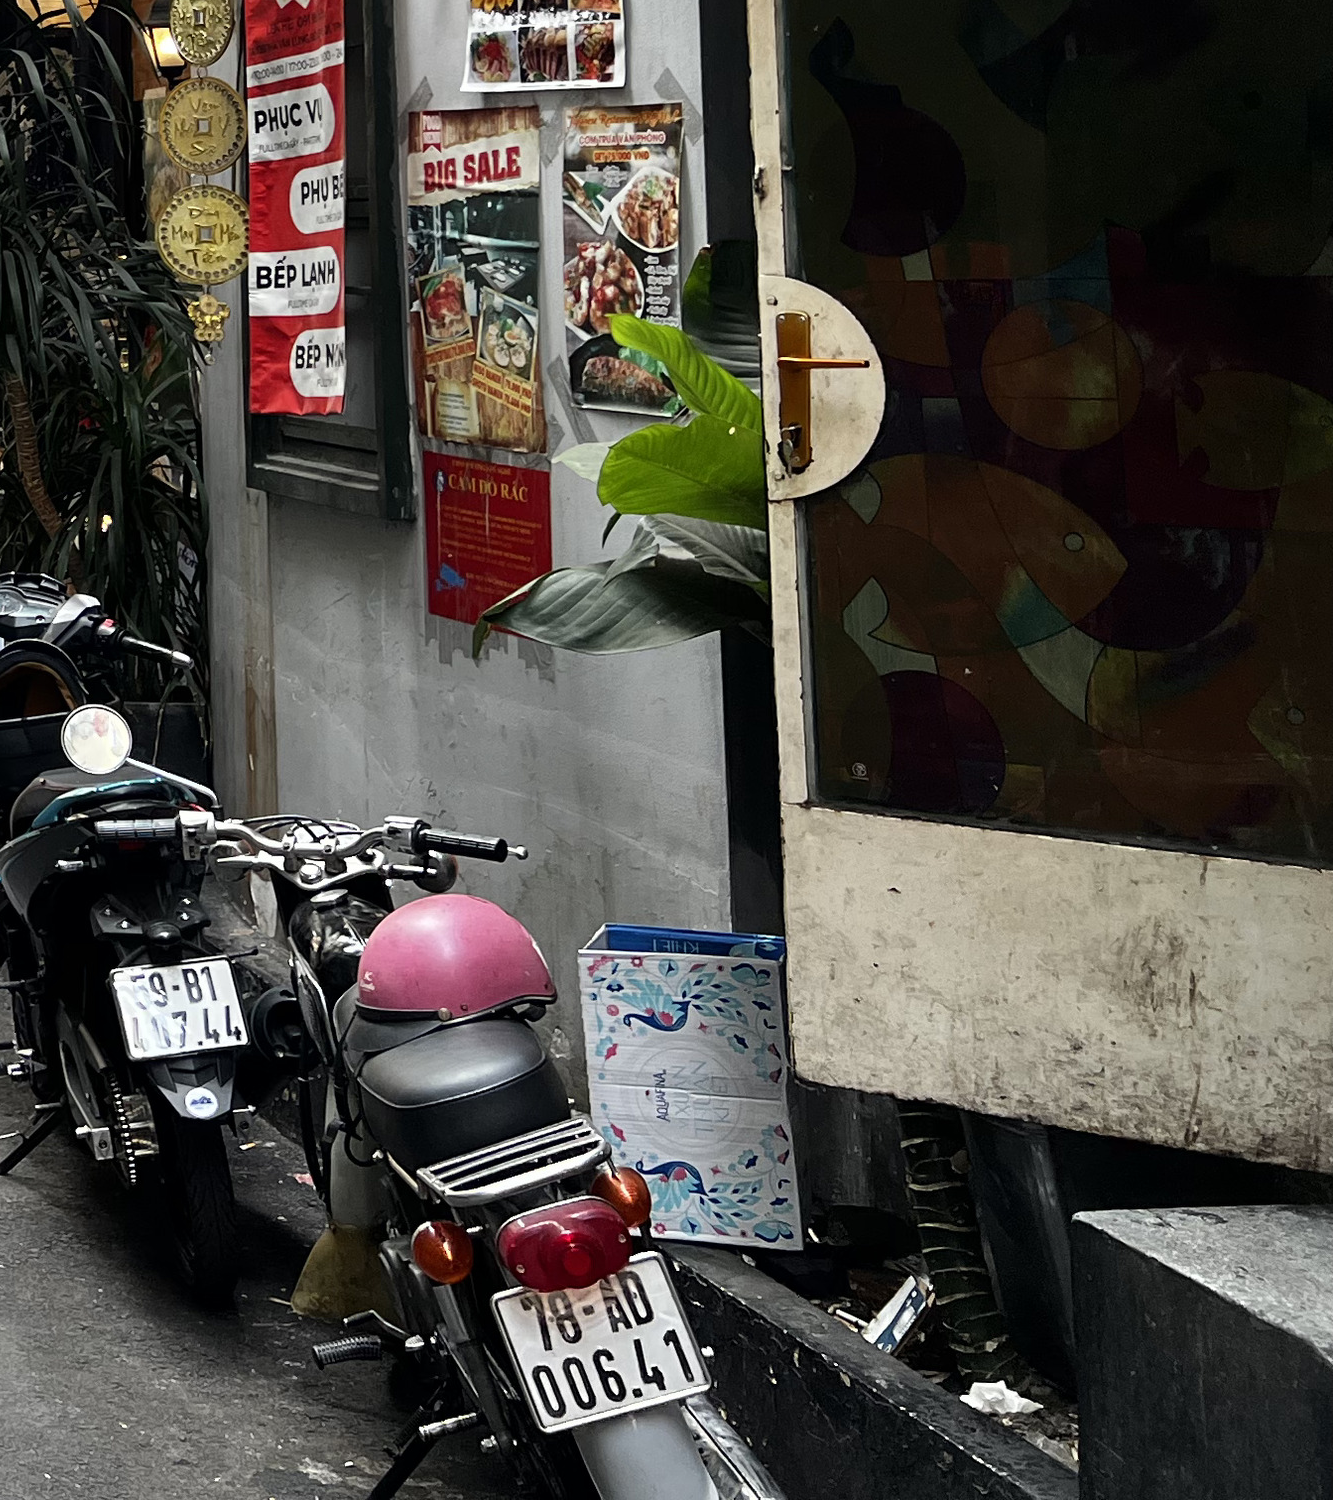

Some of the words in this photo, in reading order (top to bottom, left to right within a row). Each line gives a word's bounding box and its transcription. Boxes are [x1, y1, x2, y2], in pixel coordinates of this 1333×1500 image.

[254, 102, 303, 136] PHỤC
[423, 158, 458, 195] BIG
[463, 145, 522, 187] SALE
[300, 176, 329, 209] PHỤ
[256, 255, 297, 290] BẾP
[301, 258, 336, 293] LẠNH
[295, 335, 321, 370] BẾP
[501, 479, 529, 503] RÁC
[653, 1068, 670, 1123] AQUAFINA
[532, 1328, 695, 1419] 006.41
